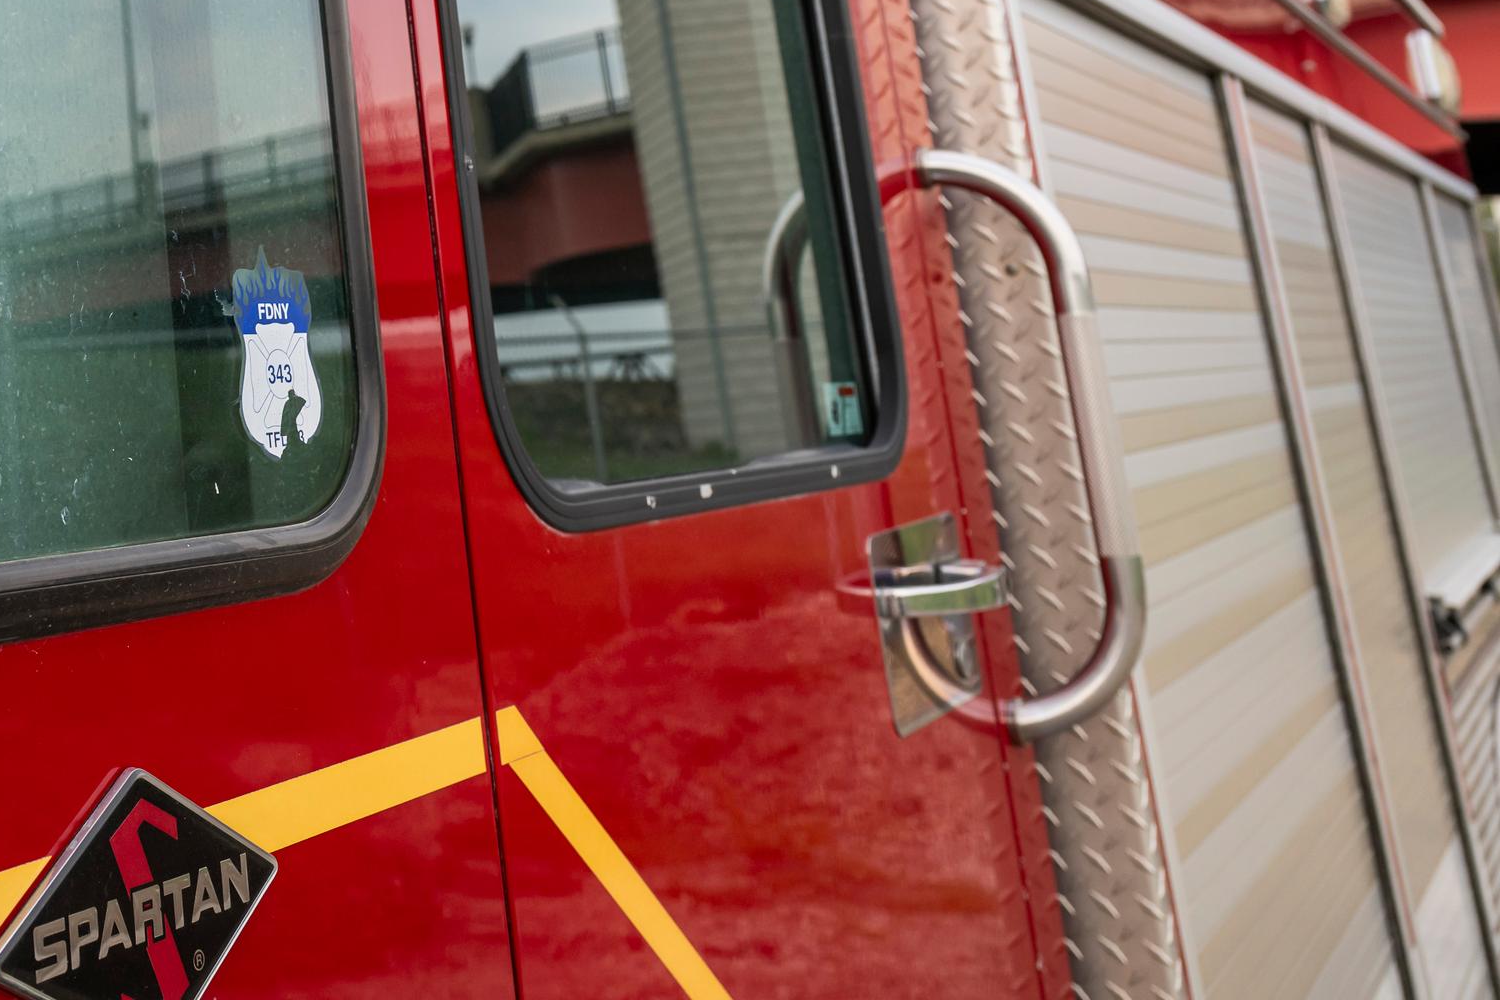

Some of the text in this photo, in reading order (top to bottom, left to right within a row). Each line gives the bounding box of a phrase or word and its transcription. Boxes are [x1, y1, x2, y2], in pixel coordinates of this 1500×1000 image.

[257, 303, 290, 320] FDNY
[267, 364, 293, 384] 343
[32, 852, 251, 984] SPARTAN
